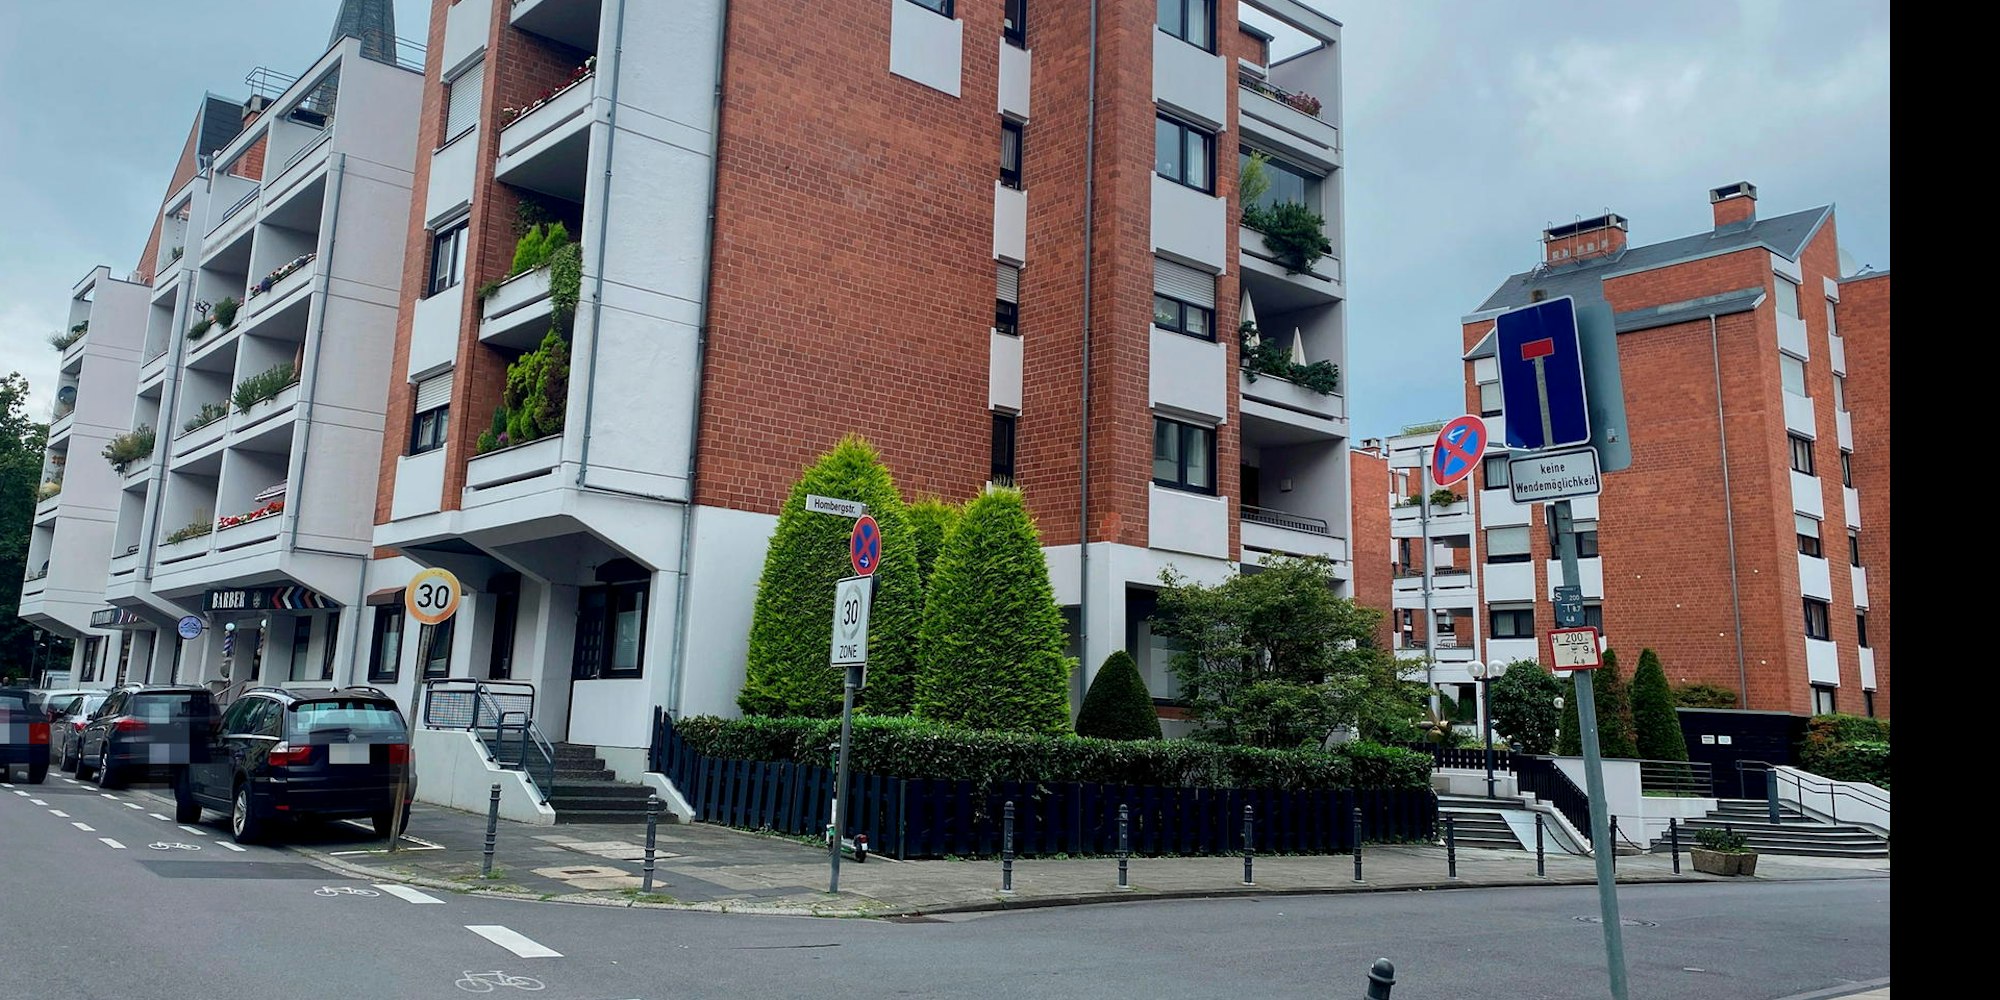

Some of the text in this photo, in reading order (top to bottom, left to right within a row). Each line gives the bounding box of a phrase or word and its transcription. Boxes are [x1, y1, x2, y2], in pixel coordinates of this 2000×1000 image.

[1540, 463, 1565, 474] keine
[1515, 475, 1596, 494] Wendemöglichkeit
[814, 498, 856, 515] Hombergstr.
[211, 590, 246, 609] BARBER
[417, 583, 450, 609] 30
[1555, 592, 1562, 601] S
[843, 600, 858, 626] 30
[1565, 632, 1583, 643] 200
[839, 644, 858, 659] ZONE
